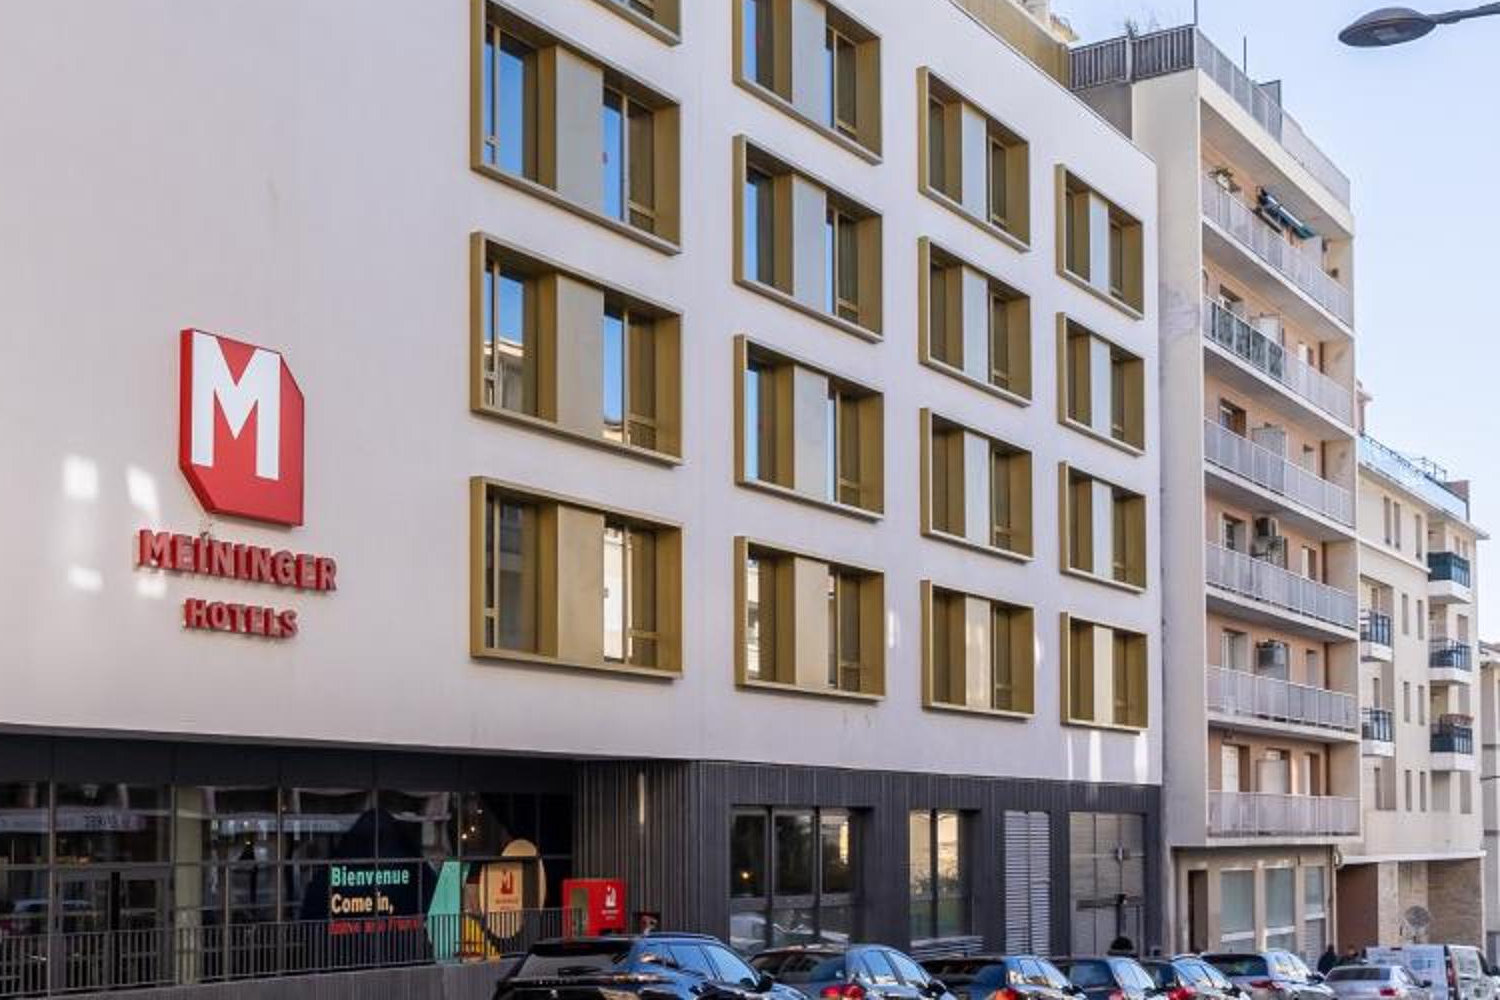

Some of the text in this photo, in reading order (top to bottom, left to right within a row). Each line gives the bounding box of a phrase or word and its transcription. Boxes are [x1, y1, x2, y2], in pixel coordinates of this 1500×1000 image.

[191, 331, 281, 481] M
[138, 529, 337, 591] MEININGER
[183, 598, 298, 638] HOTELS
[331, 866, 410, 887] Bienvenue
[331, 891, 395, 914] Come in,
